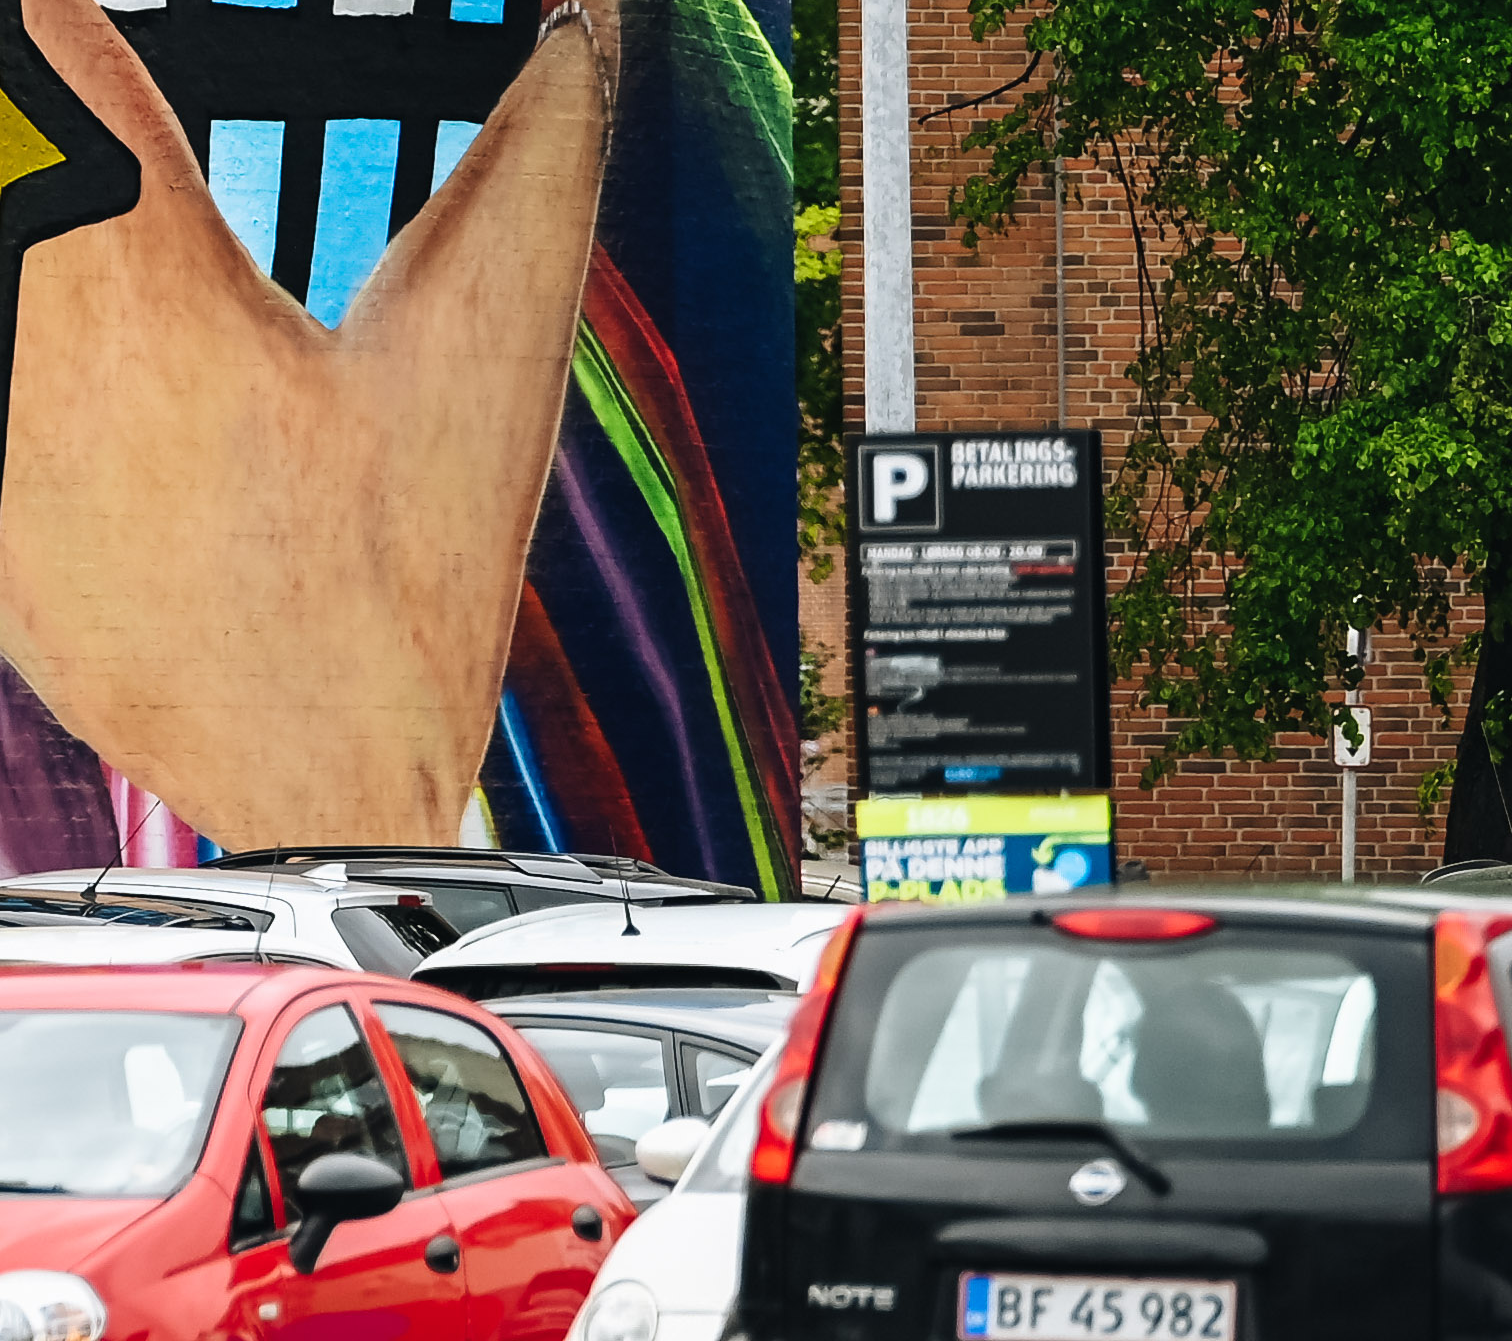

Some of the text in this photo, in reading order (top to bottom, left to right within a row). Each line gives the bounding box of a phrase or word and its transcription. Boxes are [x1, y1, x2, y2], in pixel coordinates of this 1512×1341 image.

[951, 439, 1074, 463] BETALINGS-
[873, 453, 928, 522] P
[951, 462, 1077, 488] PARKERING
[908, 856, 1003, 880] DENNE
[808, 1284, 894, 1311] NOTE
[997, 1286, 1223, 1338] BF 45 982
